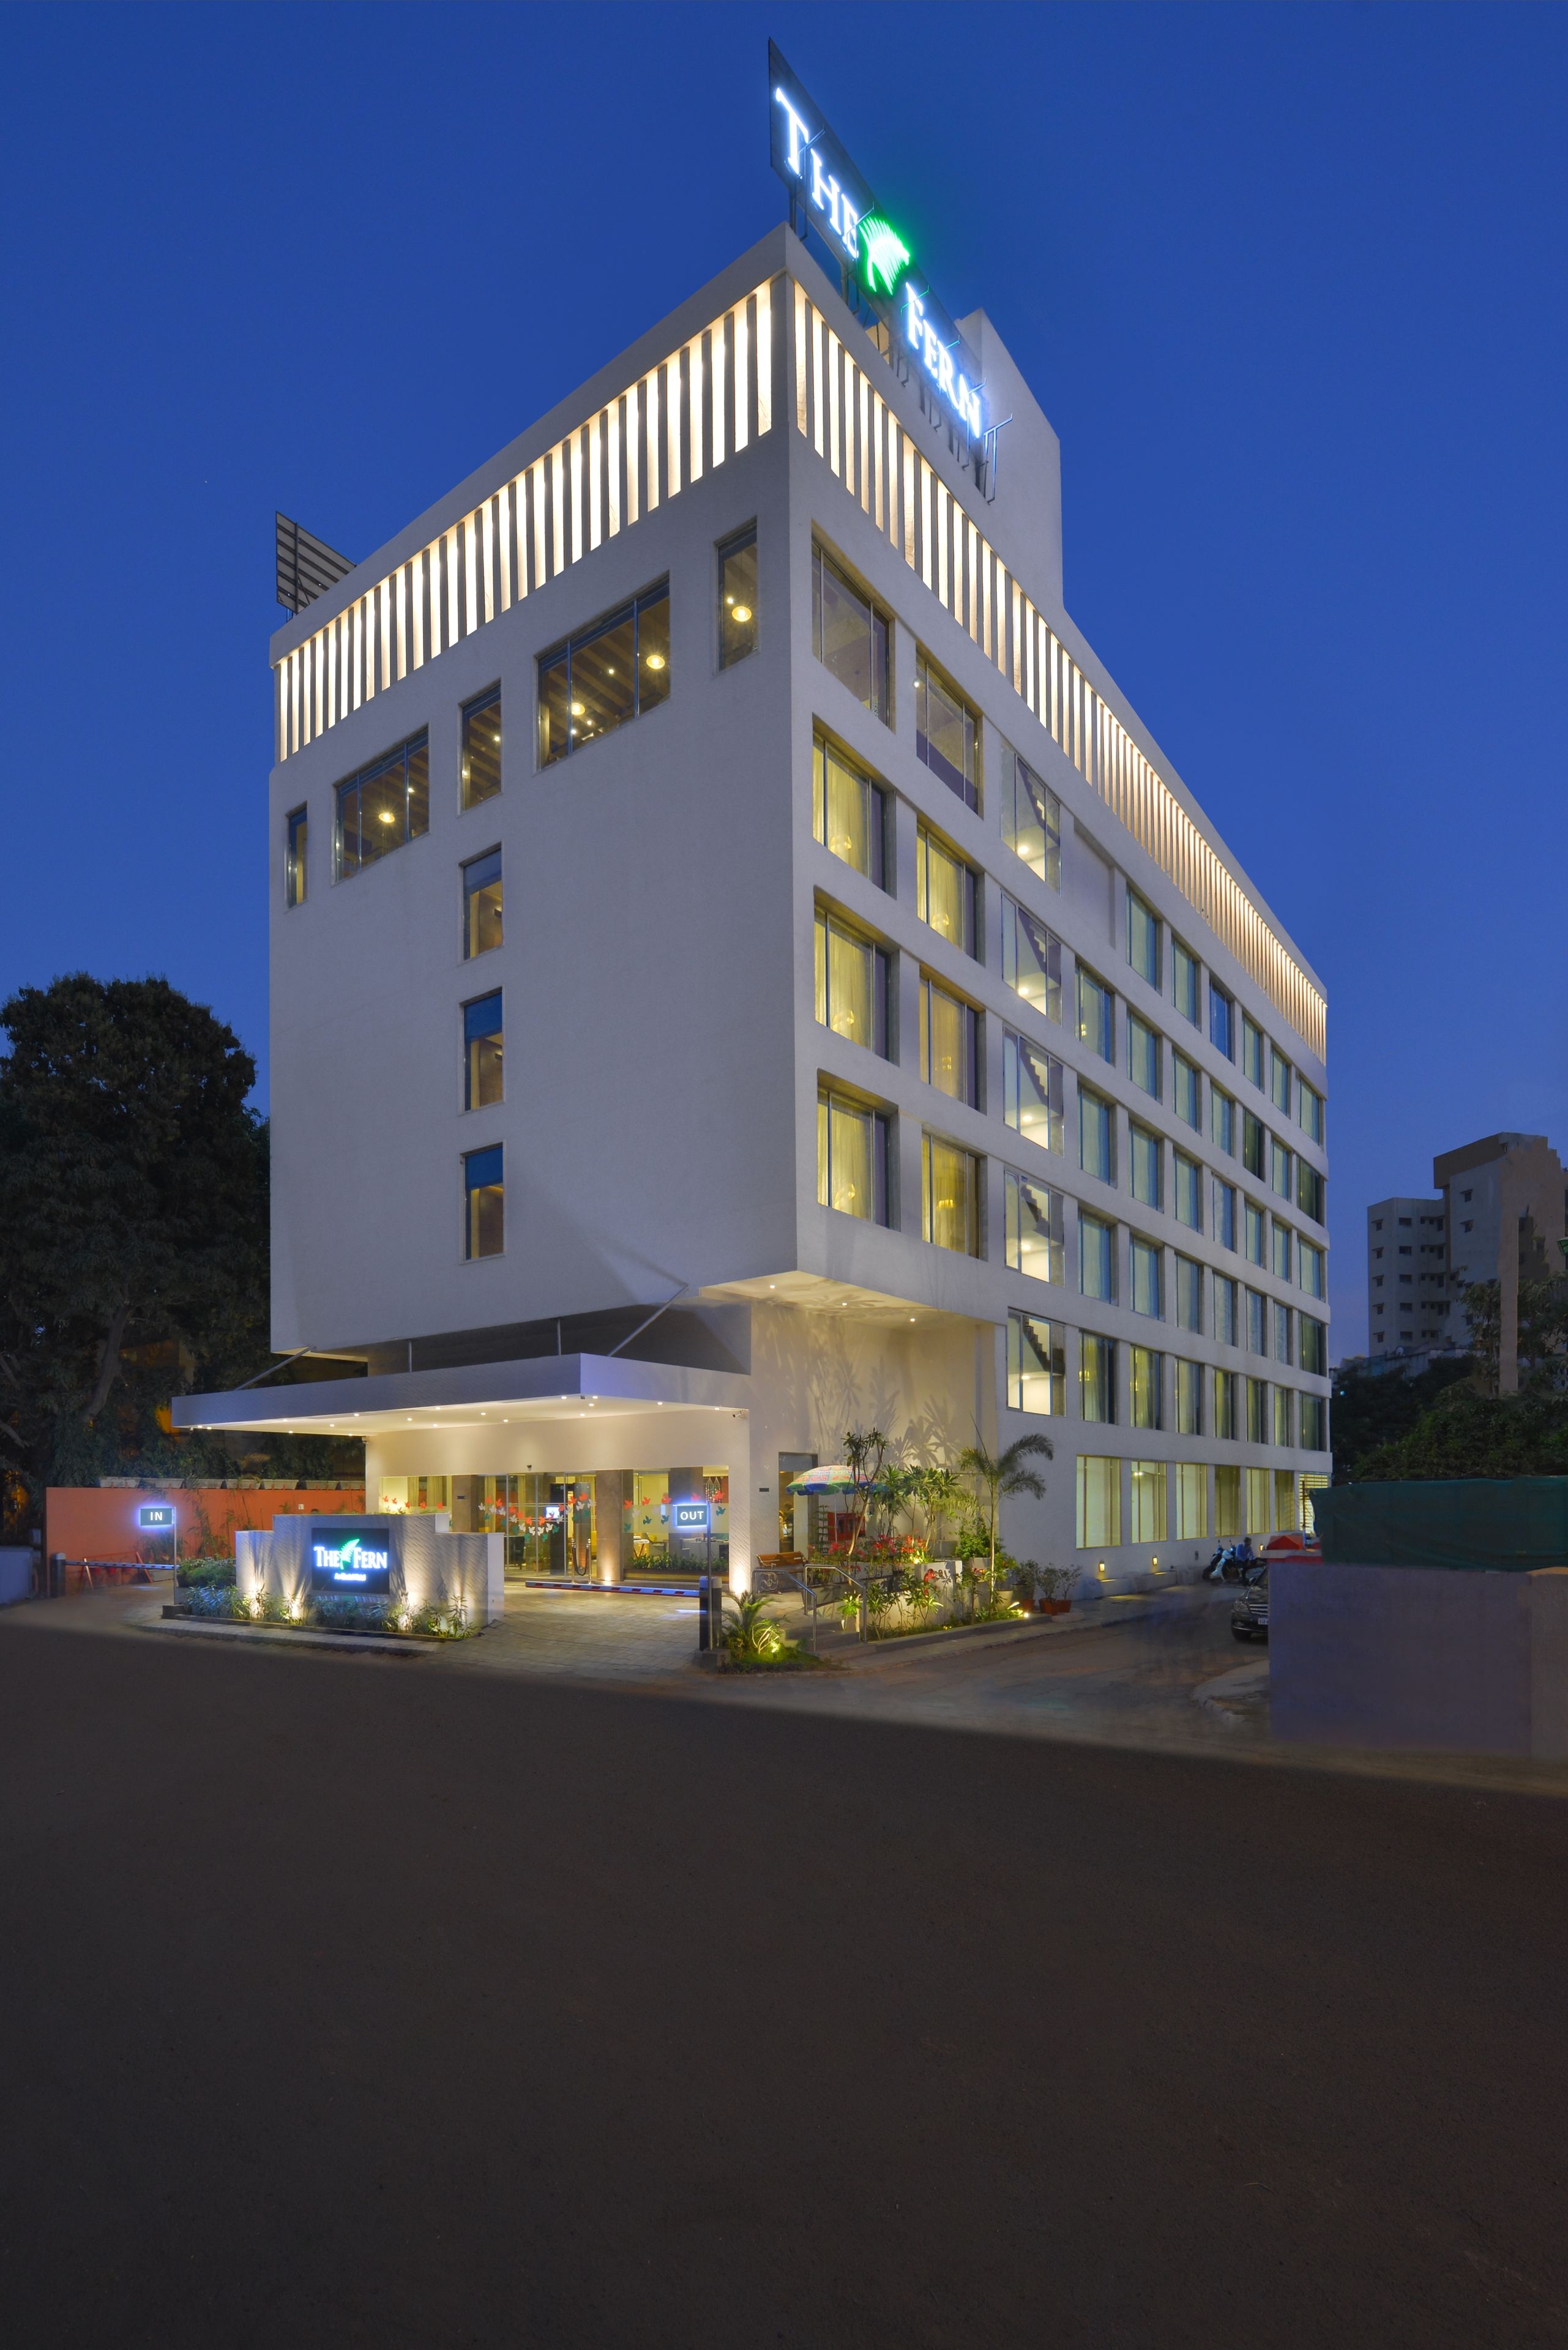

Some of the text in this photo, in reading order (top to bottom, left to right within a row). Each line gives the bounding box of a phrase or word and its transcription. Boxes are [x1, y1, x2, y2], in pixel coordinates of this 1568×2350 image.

[905, 281, 980, 439] FERN
[150, 1512, 163, 1521] IN
[680, 1511, 704, 1520] OUT
[313, 1546, 387, 1569] THE FERN
